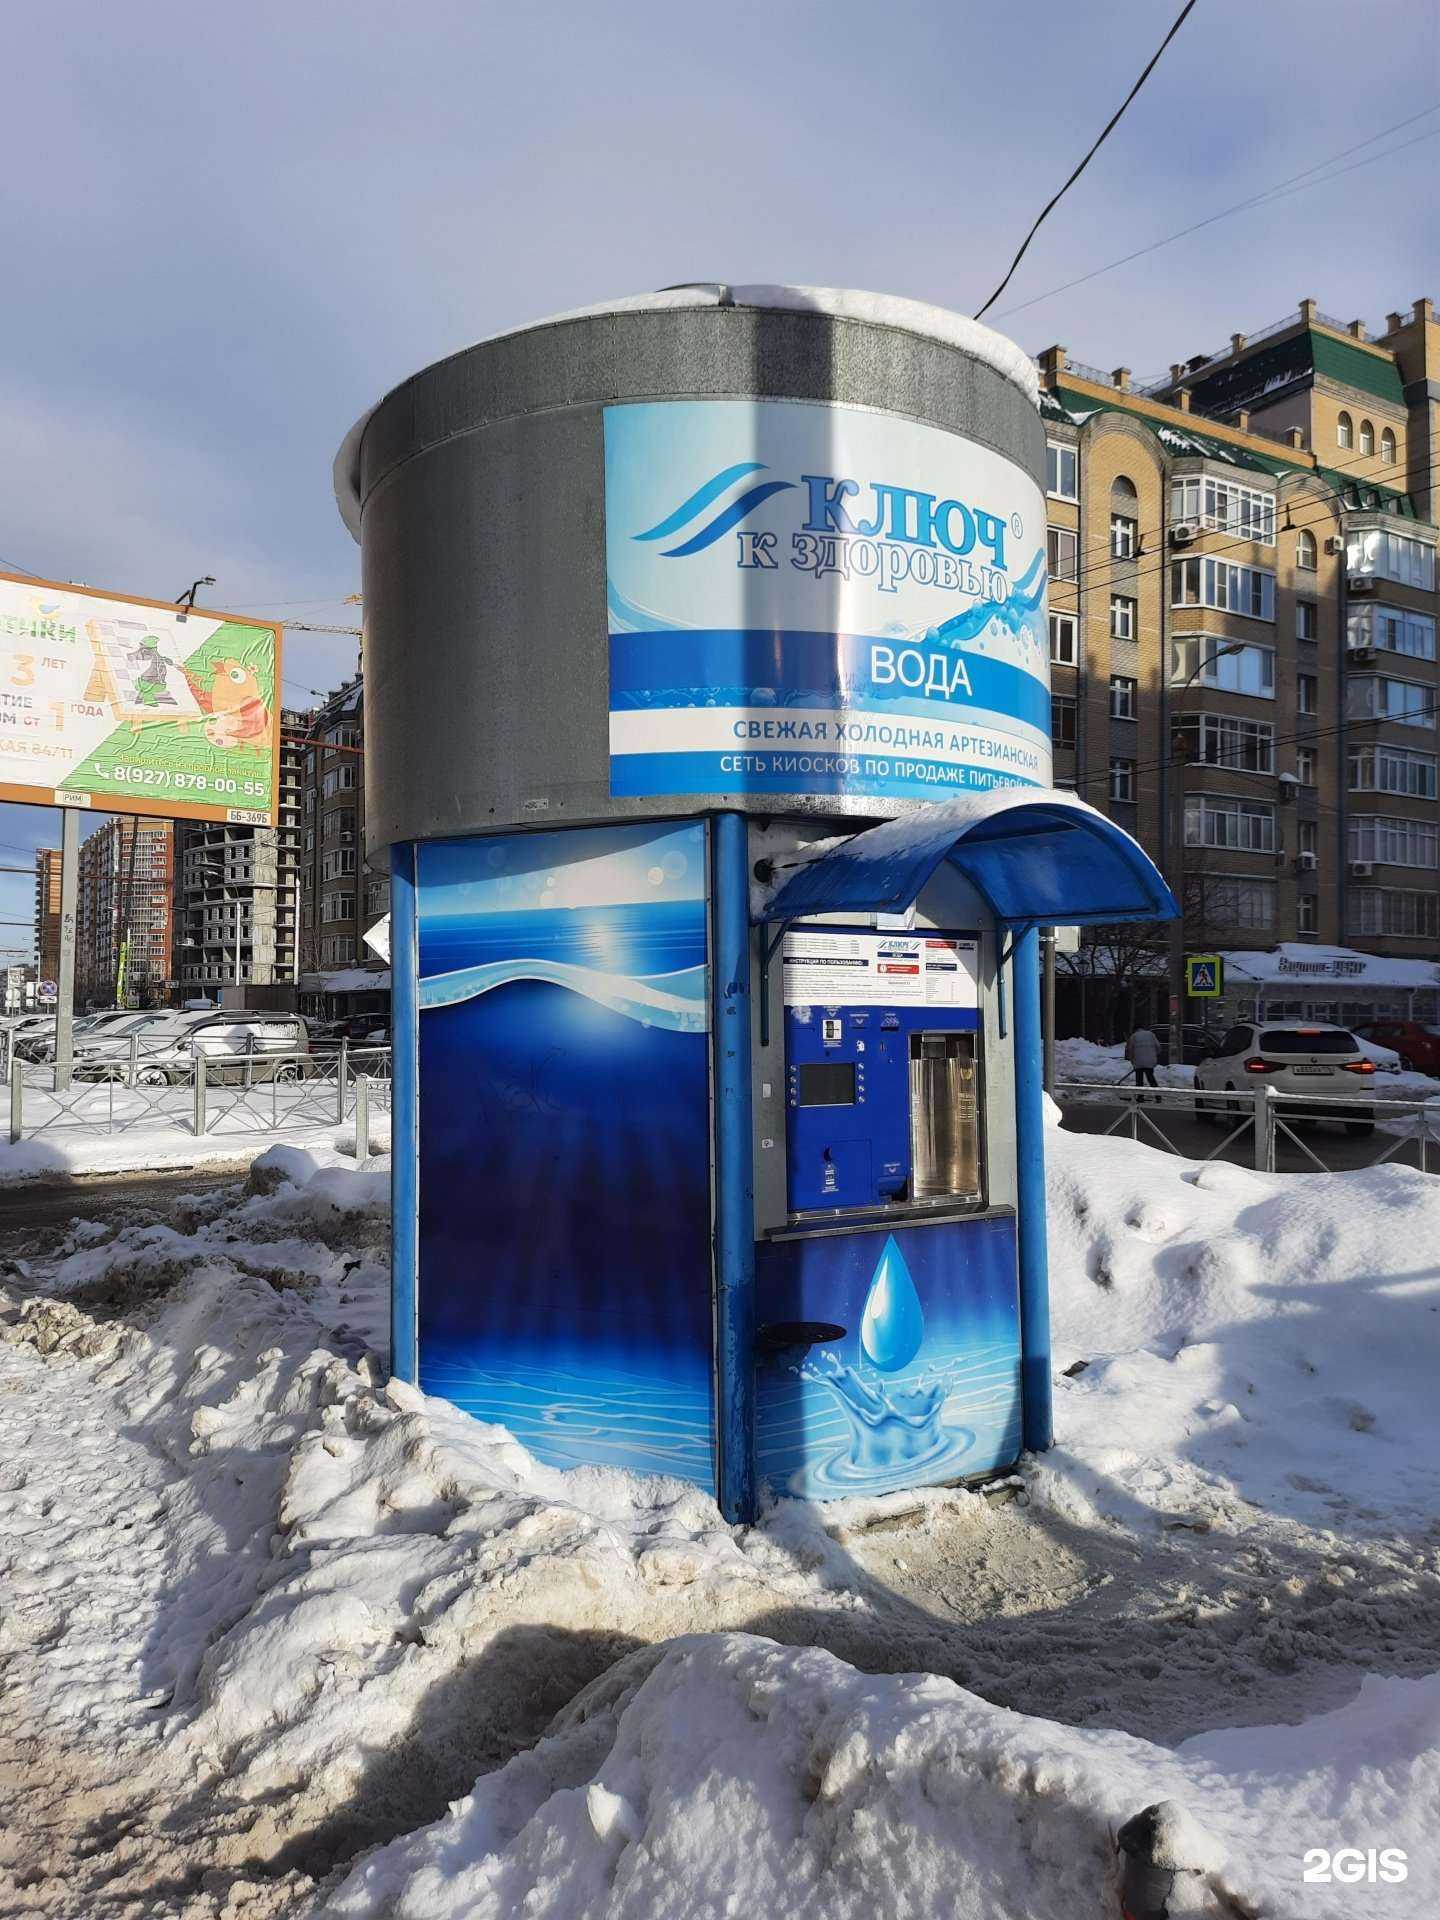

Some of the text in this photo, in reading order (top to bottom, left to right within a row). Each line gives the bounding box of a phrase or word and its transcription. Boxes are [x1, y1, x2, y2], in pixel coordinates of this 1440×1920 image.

[10, 653, 67, 686] 3 ЛЕТ
[871, 645, 973, 701] ВОДА
[71, 703, 104, 717] ГОДА
[733, 719, 1040, 769] СВЕЖАЯ ХОЛОДНАЯ АРТЕЗИАНСКАЯ
[114, 766, 265, 797] 8(927) 878-00-55
[720, 755, 767, 773] СЕТЬ
[772, 755, 862, 775] КИОСКОВ
[866, 757, 890, 776] ПО
[895, 760, 966, 785] ПРОДАЖЕ
